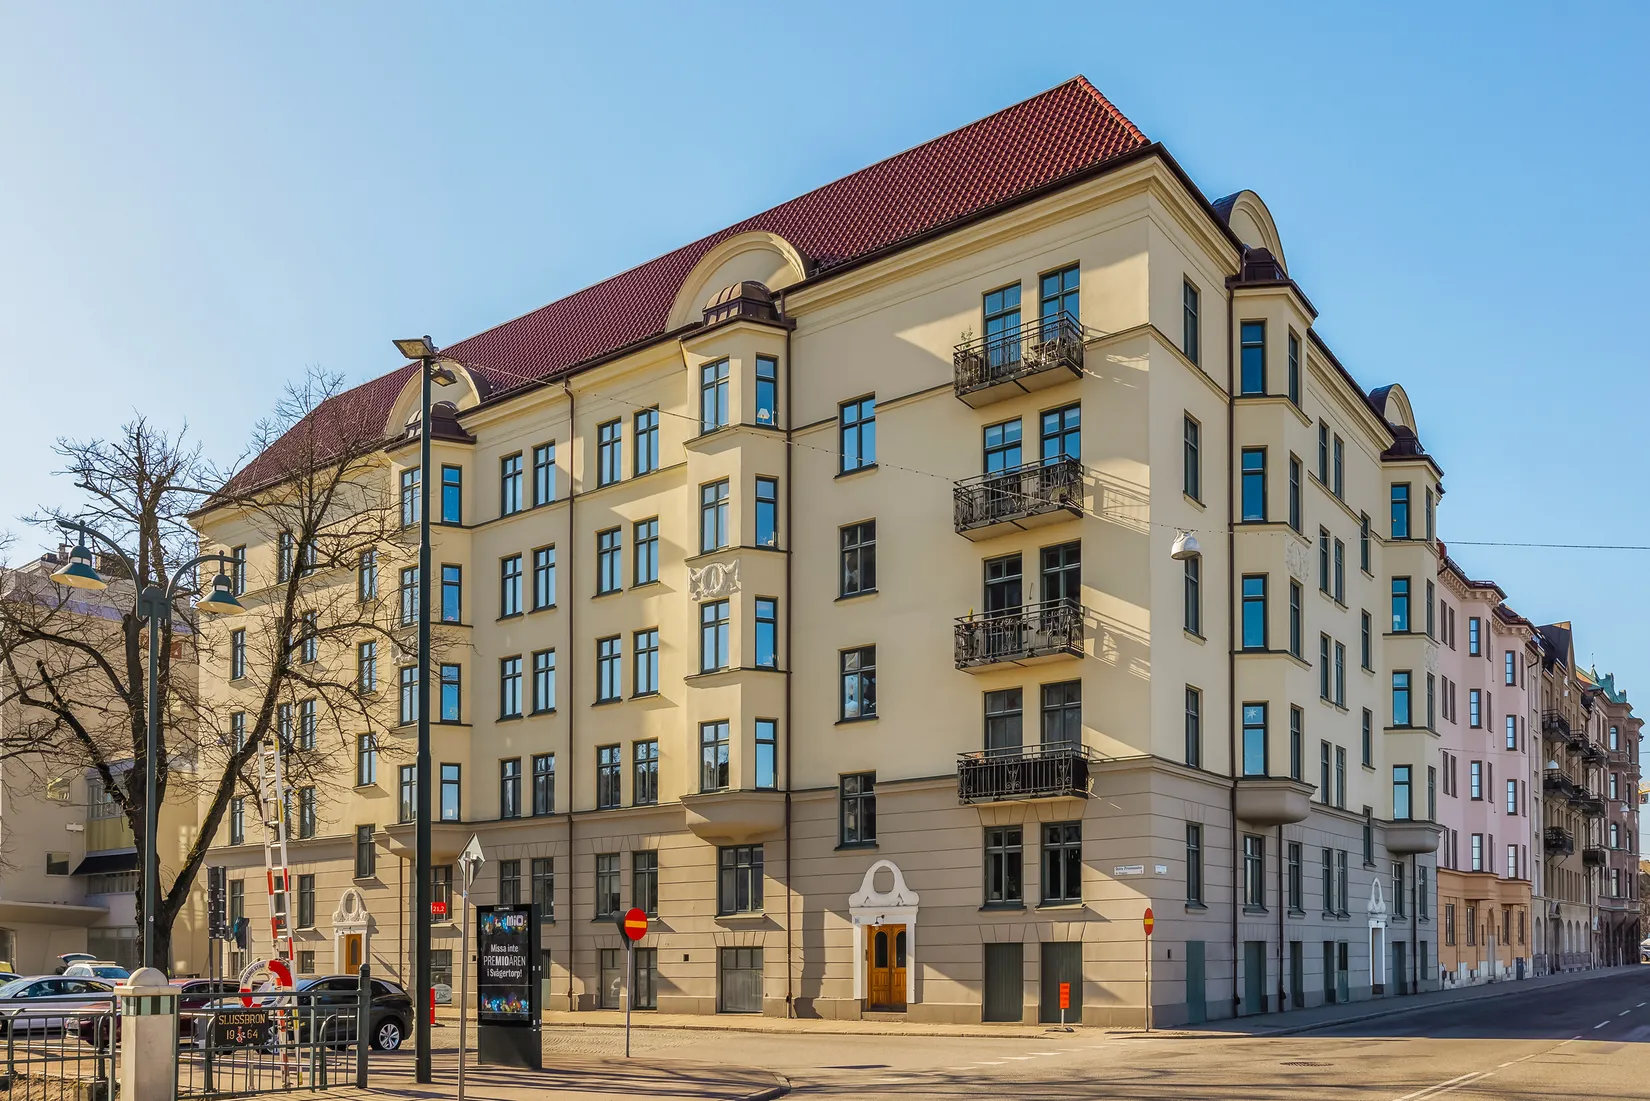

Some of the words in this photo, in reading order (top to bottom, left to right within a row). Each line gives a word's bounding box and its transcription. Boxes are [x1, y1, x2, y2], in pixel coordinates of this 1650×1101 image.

[490, 944, 507, 953] Missa
[507, 944, 519, 953] inte
[490, 968, 523, 979] Svågertorp!
[218, 1013, 266, 1025] SLUSSBRON
[226, 1029, 235, 1040] 19
[246, 1029, 259, 1039] 64
